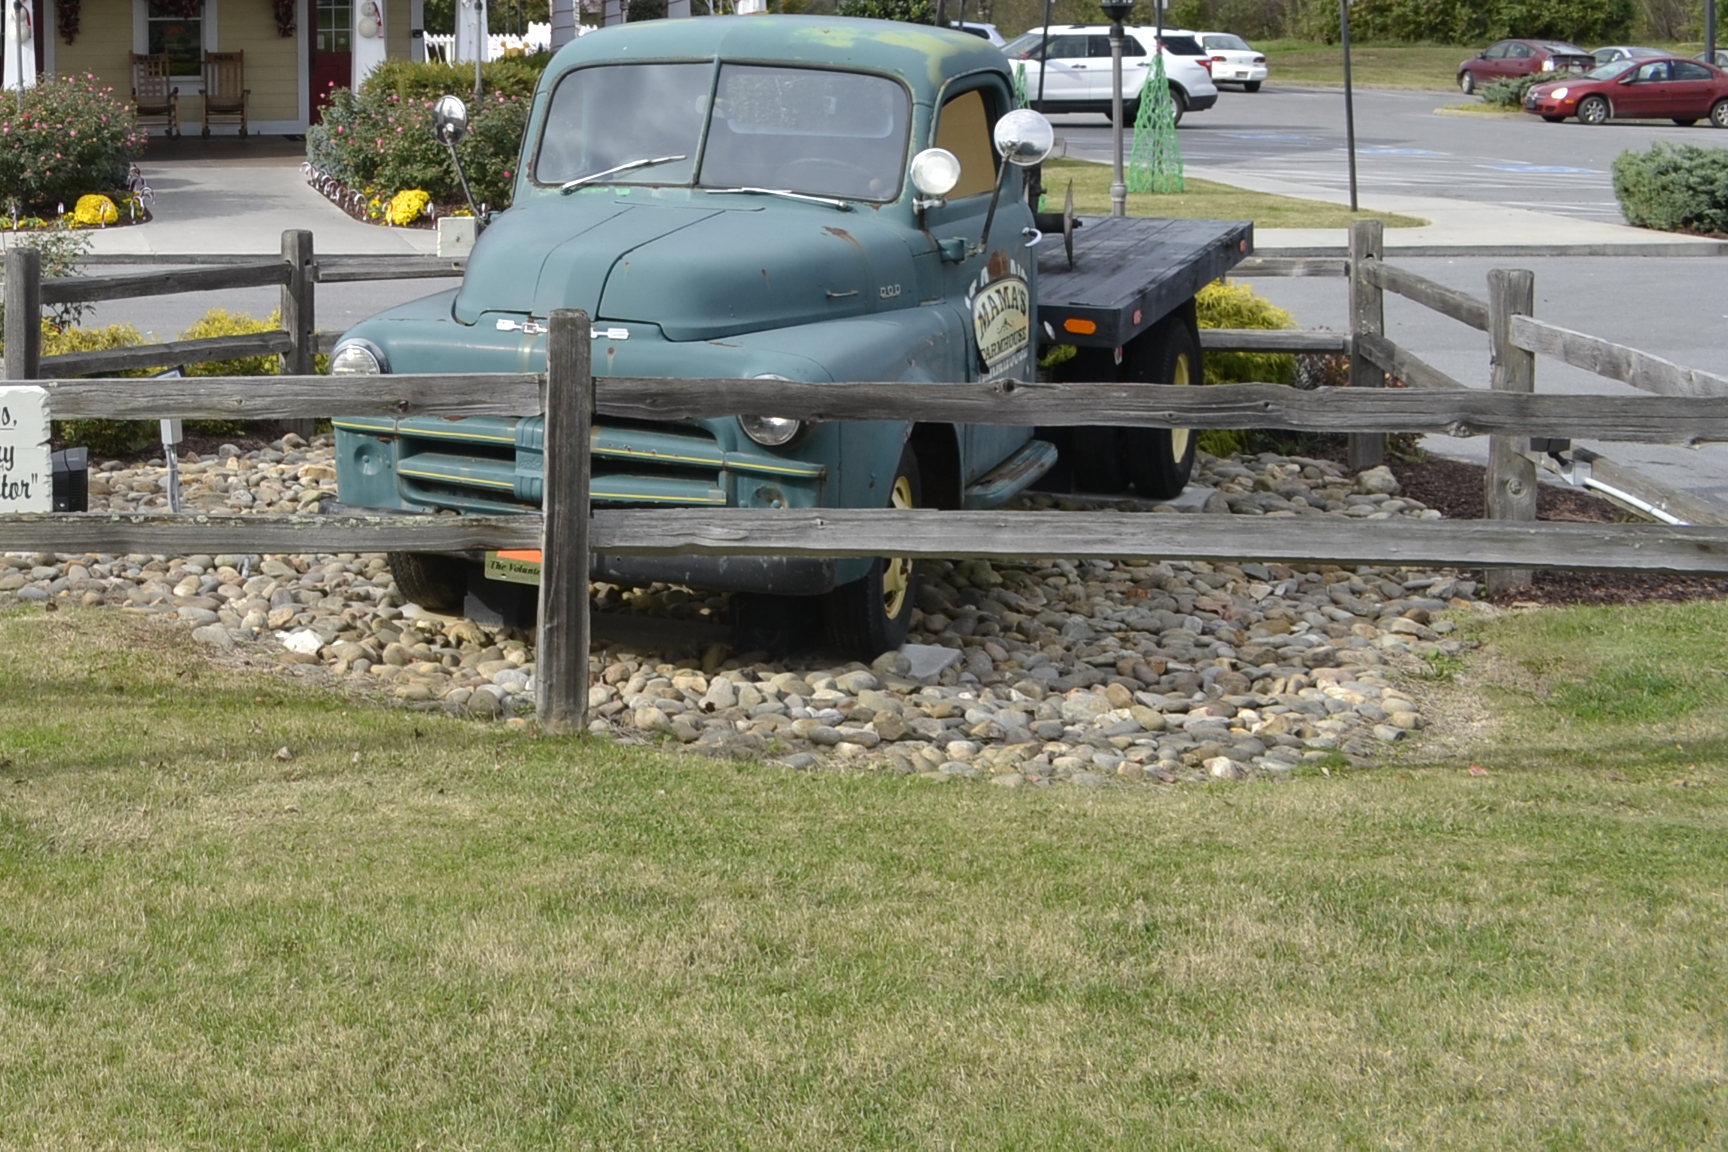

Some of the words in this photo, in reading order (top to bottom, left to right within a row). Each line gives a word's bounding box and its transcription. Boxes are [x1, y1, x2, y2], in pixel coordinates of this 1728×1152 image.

[978, 286, 1027, 341] MAMA'S
[490, 560, 507, 571] The
[509, 562, 541, 575] Volunte
